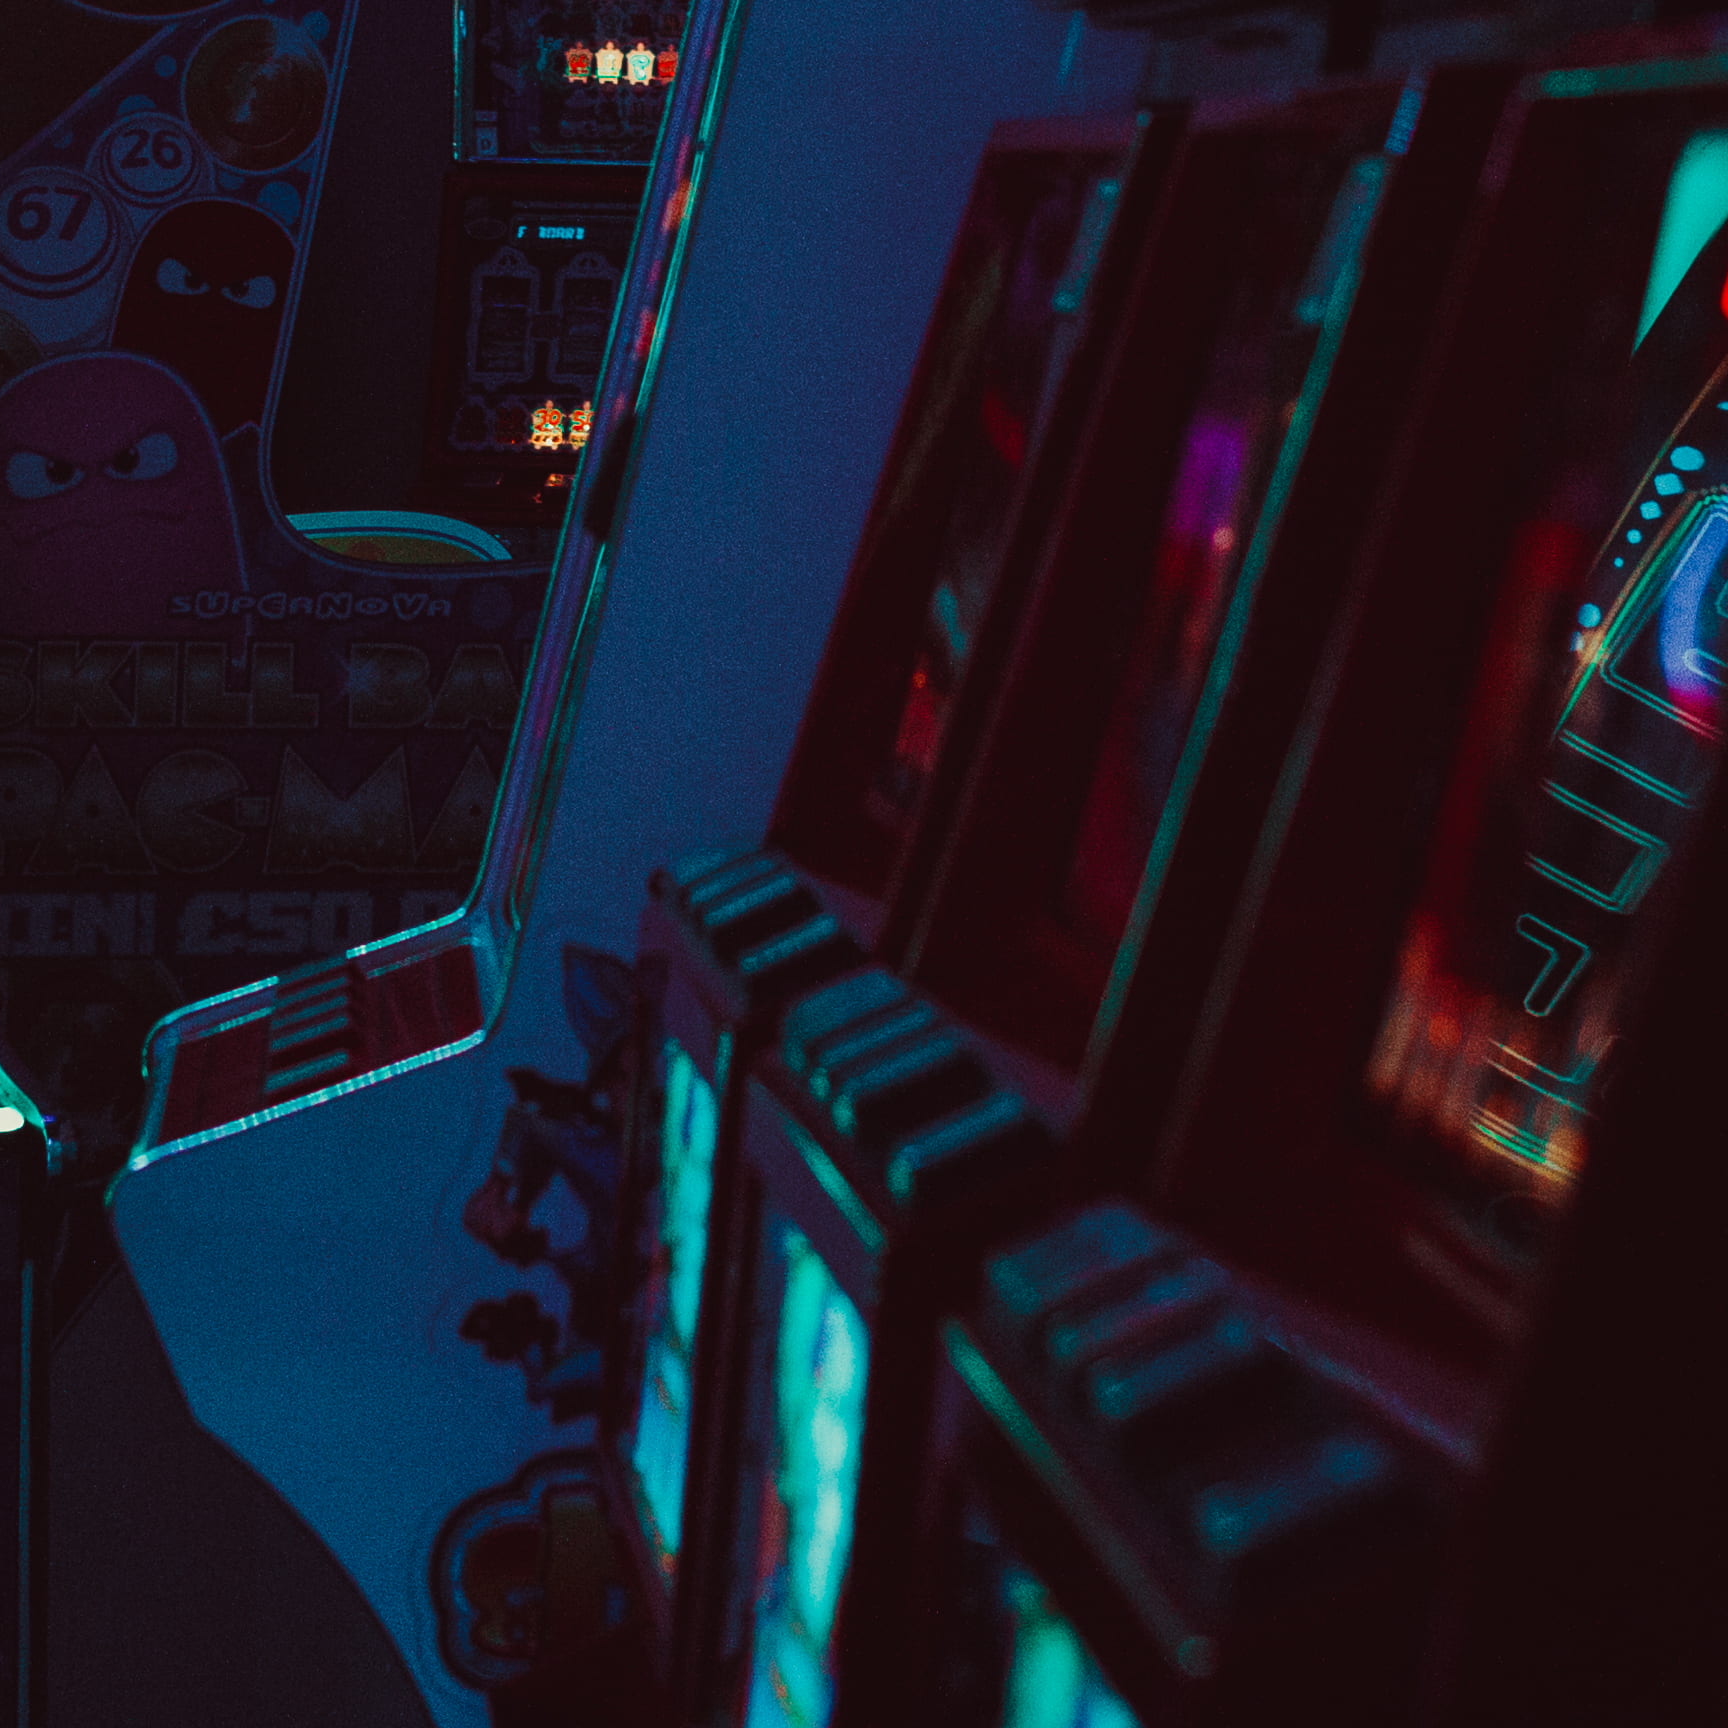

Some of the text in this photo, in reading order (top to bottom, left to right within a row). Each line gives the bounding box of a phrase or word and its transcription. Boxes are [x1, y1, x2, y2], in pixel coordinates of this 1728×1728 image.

[121, 129, 183, 170] 26
[7, 185, 92, 242] 67
[347, 641, 529, 729] BA
